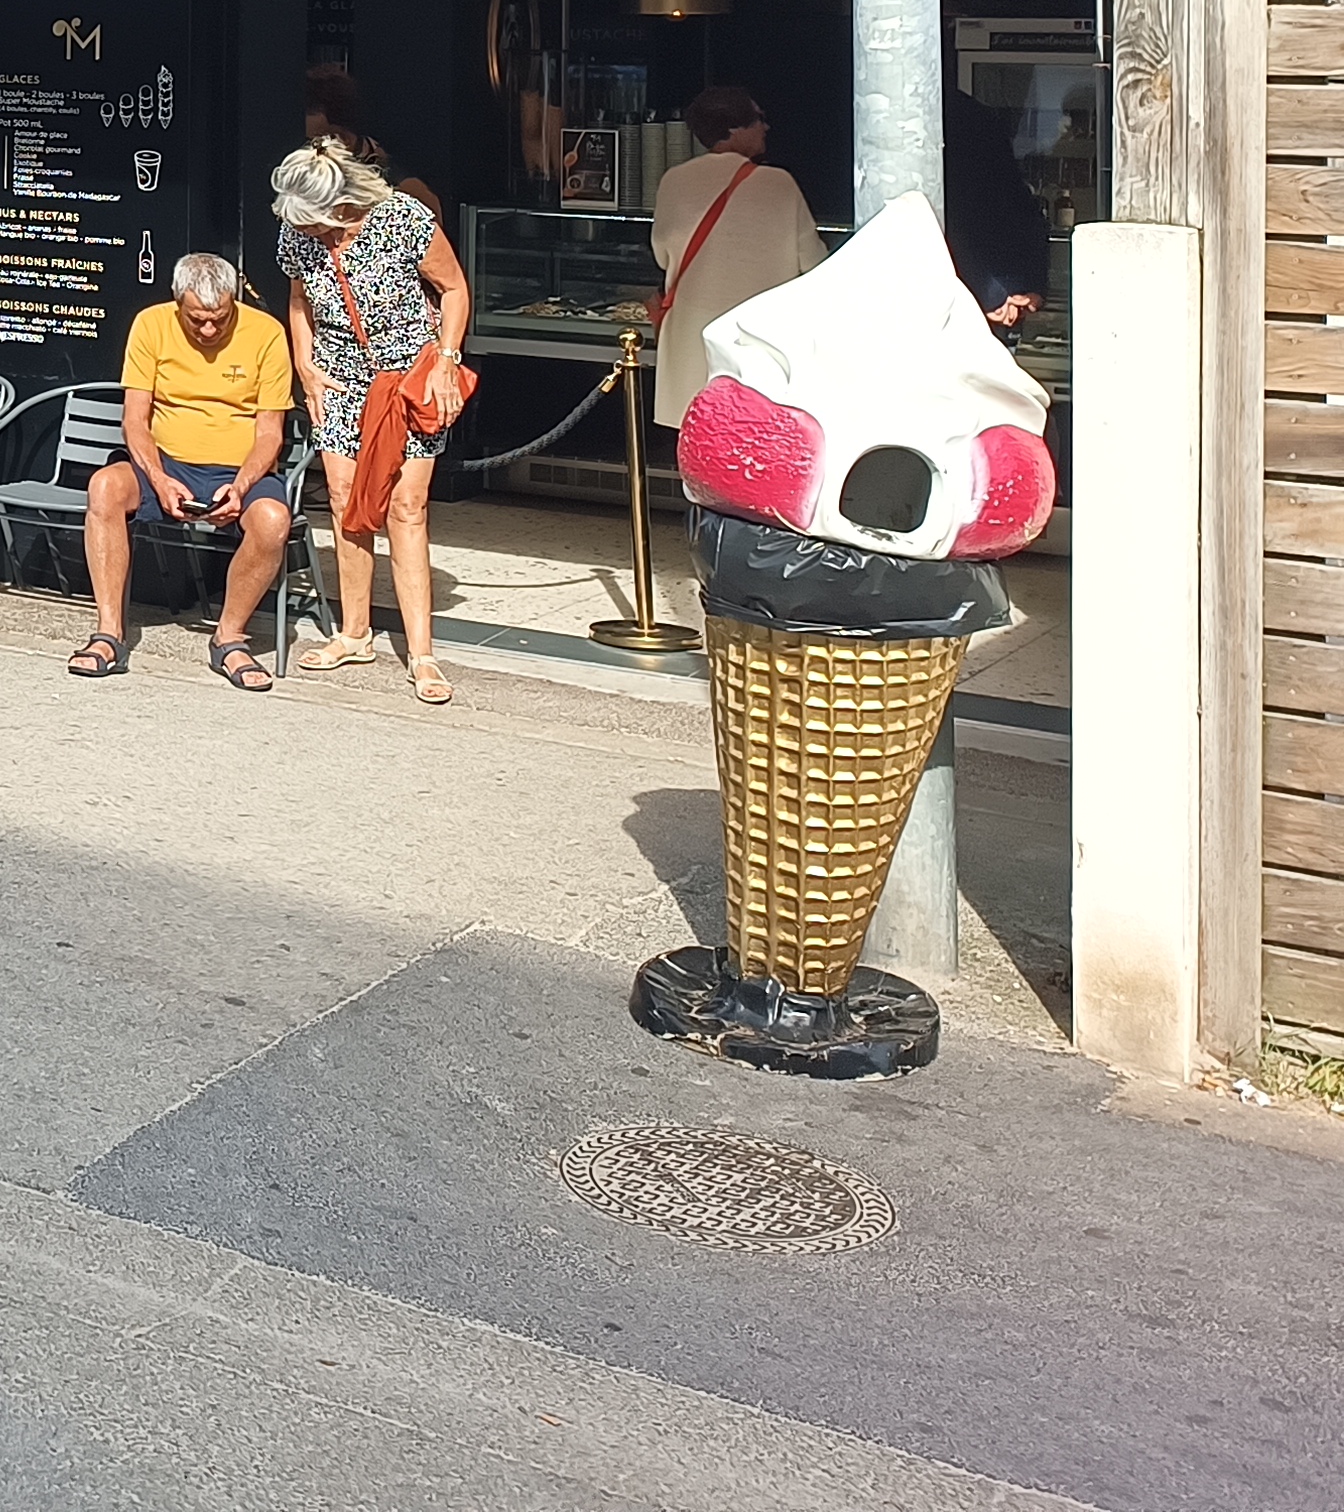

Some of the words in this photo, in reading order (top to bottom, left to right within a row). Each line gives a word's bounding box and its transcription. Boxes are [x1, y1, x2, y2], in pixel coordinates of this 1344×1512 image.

[3, 89, 25, 97] boule
[32, 90, 37, 98] 2
[38, 90, 64, 99] boules
[71, 91, 77, 99] 3
[79, 91, 105, 100] boules
[22, 97, 65, 107] Moustache
[13, 119, 29, 128] 500
[14, 152, 37, 160] Cookie
[45, 146, 81, 155] gourmand
[19, 209, 27, 219] &
[29, 210, 80, 223] NECTARS
[24, 232, 36, 240] bio
[113, 238, 125, 246] bio
[51, 258, 104, 272] FRAÎCHES
[52, 304, 106, 318] CHAUDES
